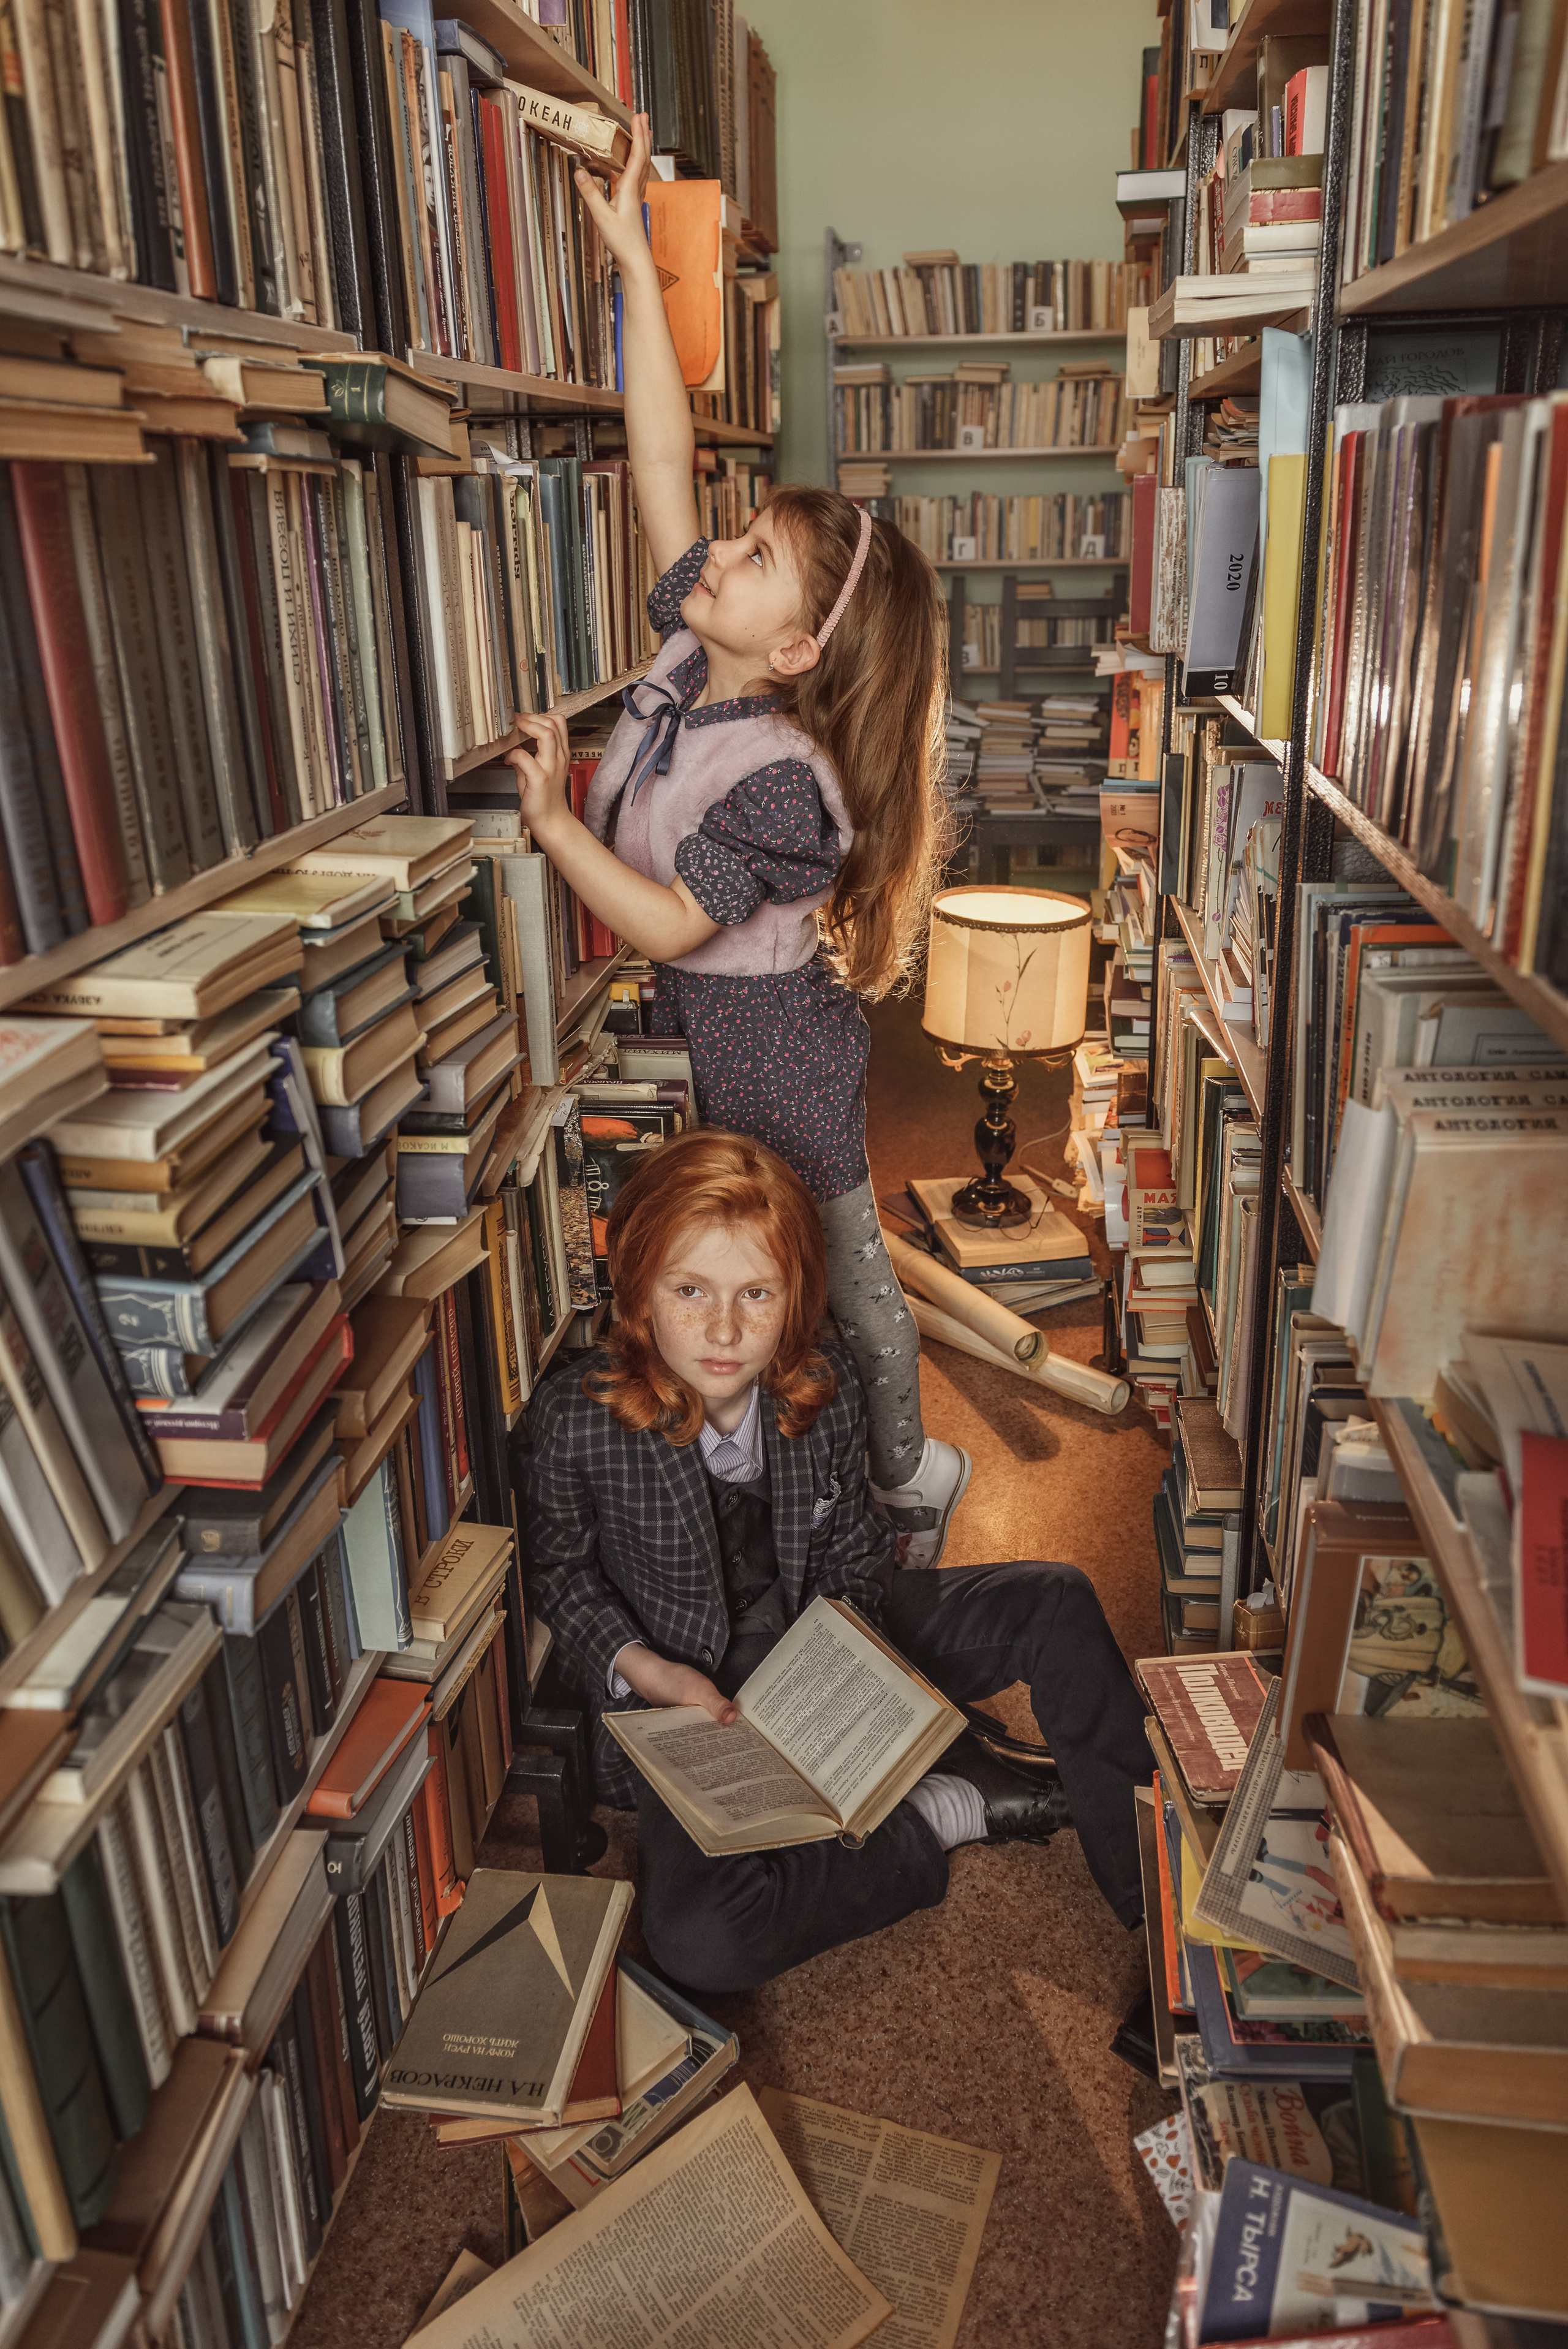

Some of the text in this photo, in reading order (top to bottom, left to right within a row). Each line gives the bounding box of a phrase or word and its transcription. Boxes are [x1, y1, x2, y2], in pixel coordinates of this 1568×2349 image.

[518, 96, 572, 130] ОКЕАН
[1288, 95, 1298, 135] БРАТСТВА
[404, 105, 413, 175] ХОЛОДНАЯ
[448, 143, 462, 265] СЕРГЕЙ ВИКУЛОВ
[829, 319, 839, 333] А
[1035, 313, 1046, 327] Б
[1397, 347, 1464, 363] ГОРОДОВ
[962, 431, 973, 445] В
[437, 507, 450, 594] Казакевиче
[448, 509, 459, 592] Казакевиче
[509, 494, 521, 581] КРЫЛОВ
[958, 543, 967, 556] Г
[1084, 542, 1096, 558] Д
[273, 489, 300, 685] СТИХИ И ПОЭЗИЯ
[1226, 554, 1244, 591] 2020
[344, 564, 358, 656] Советская
[353, 659, 368, 738] Русская
[449, 635, 463, 730] Воспоминания
[458, 634, 472, 726] Воспоминания
[1214, 673, 1229, 690] 10
[1263, 801, 1283, 817] МЕ
[53, 994, 101, 1006] АЗБУКА
[1404, 1070, 1518, 1083] АНТОЛОГИЯ
[1412, 1095, 1531, 1108] АНТОЛОГИЯ
[1435, 1118, 1558, 1132] АНТОЛОГИЯ
[1144, 1193, 1177, 1203] МАЯ
[118, 1313, 140, 1326] 2
[448, 1307, 464, 1418] АНДРЕЙ НЕМЗЕР
[423, 1539, 475, 1588] СТРОКИ
[316, 1609, 327, 1658] ГИНЗБУРГ
[1218, 1663, 1230, 1682] Борис
[1175, 1663, 1249, 1771] ПОЛКОВОДЕЦ
[1257, 1734, 1275, 1779] ИЗДАТЕЛЬСТВО
[405, 1815, 417, 1869] ДНЕВНИК
[412, 1876, 425, 1953] ЧУКОВСКИЙ
[358, 1997, 376, 2070] СЕРГЕЙ
[442, 2034, 519, 2048] ЖИТЬ ХОРОШО
[443, 2043, 471, 2054] РУСИ
[486, 2049, 515, 2058] КОМУ
[390, 2070, 502, 2093] НЕКРАСОВ
[1239, 2082, 1259, 2124] Судьба
[1272, 2085, 1313, 2166] Война
[1231, 2174, 1272, 2301] Н. ТЫРСА
